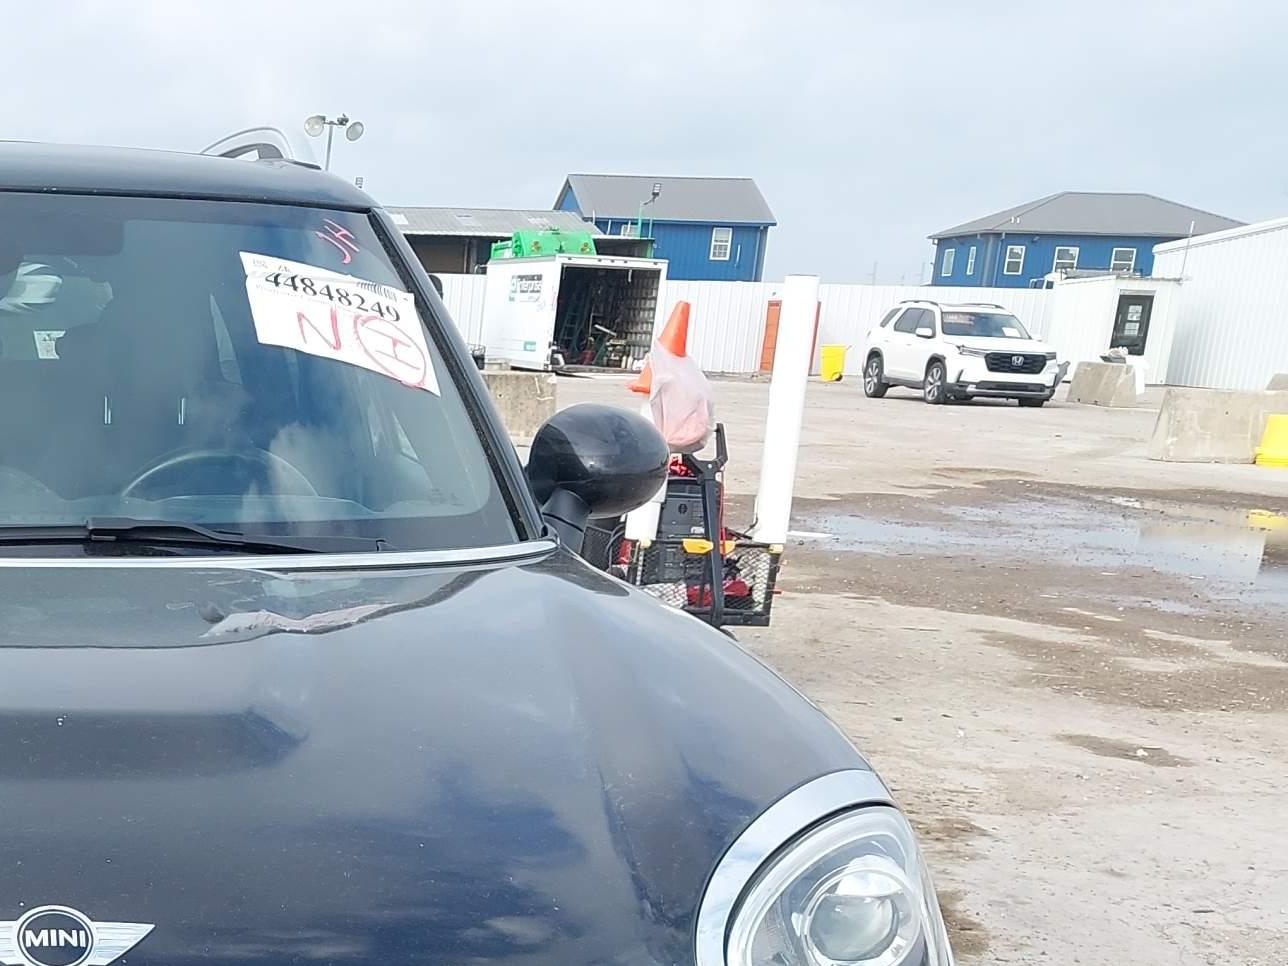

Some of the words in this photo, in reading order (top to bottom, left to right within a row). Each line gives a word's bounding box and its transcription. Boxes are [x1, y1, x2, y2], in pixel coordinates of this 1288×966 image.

[265, 272, 400, 321] 44848249
[297, 307, 341, 351] N
[25, 929, 86, 948] MINI
